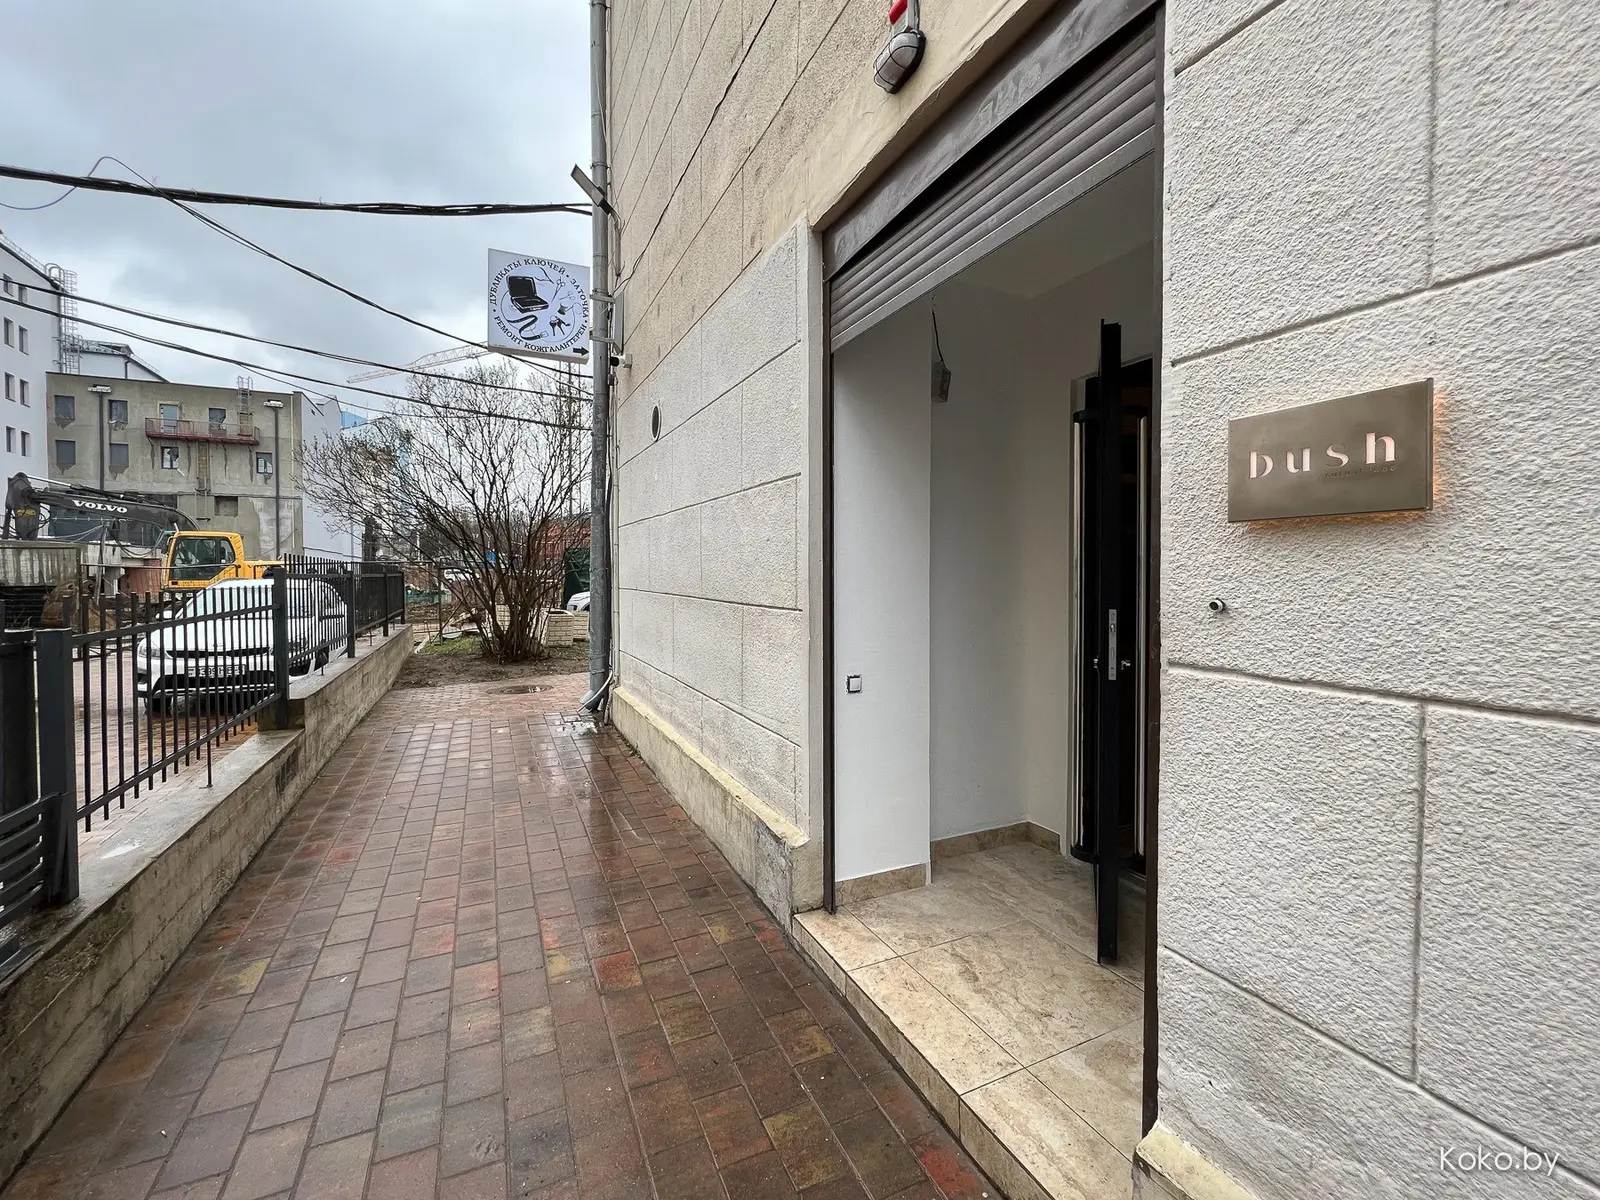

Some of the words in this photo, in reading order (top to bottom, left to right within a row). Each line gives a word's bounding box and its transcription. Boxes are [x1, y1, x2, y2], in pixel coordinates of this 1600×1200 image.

[489, 260, 522, 306] ДУБЛИКАТЫ
[524, 258, 566, 275] КЛЮЧЕЙ
[570, 278, 589, 318] ЗАТОЧКА
[493, 315, 523, 345] РЕМОНТ
[1248, 432, 1396, 480] bush
[71, 499, 128, 514] VOLVO
